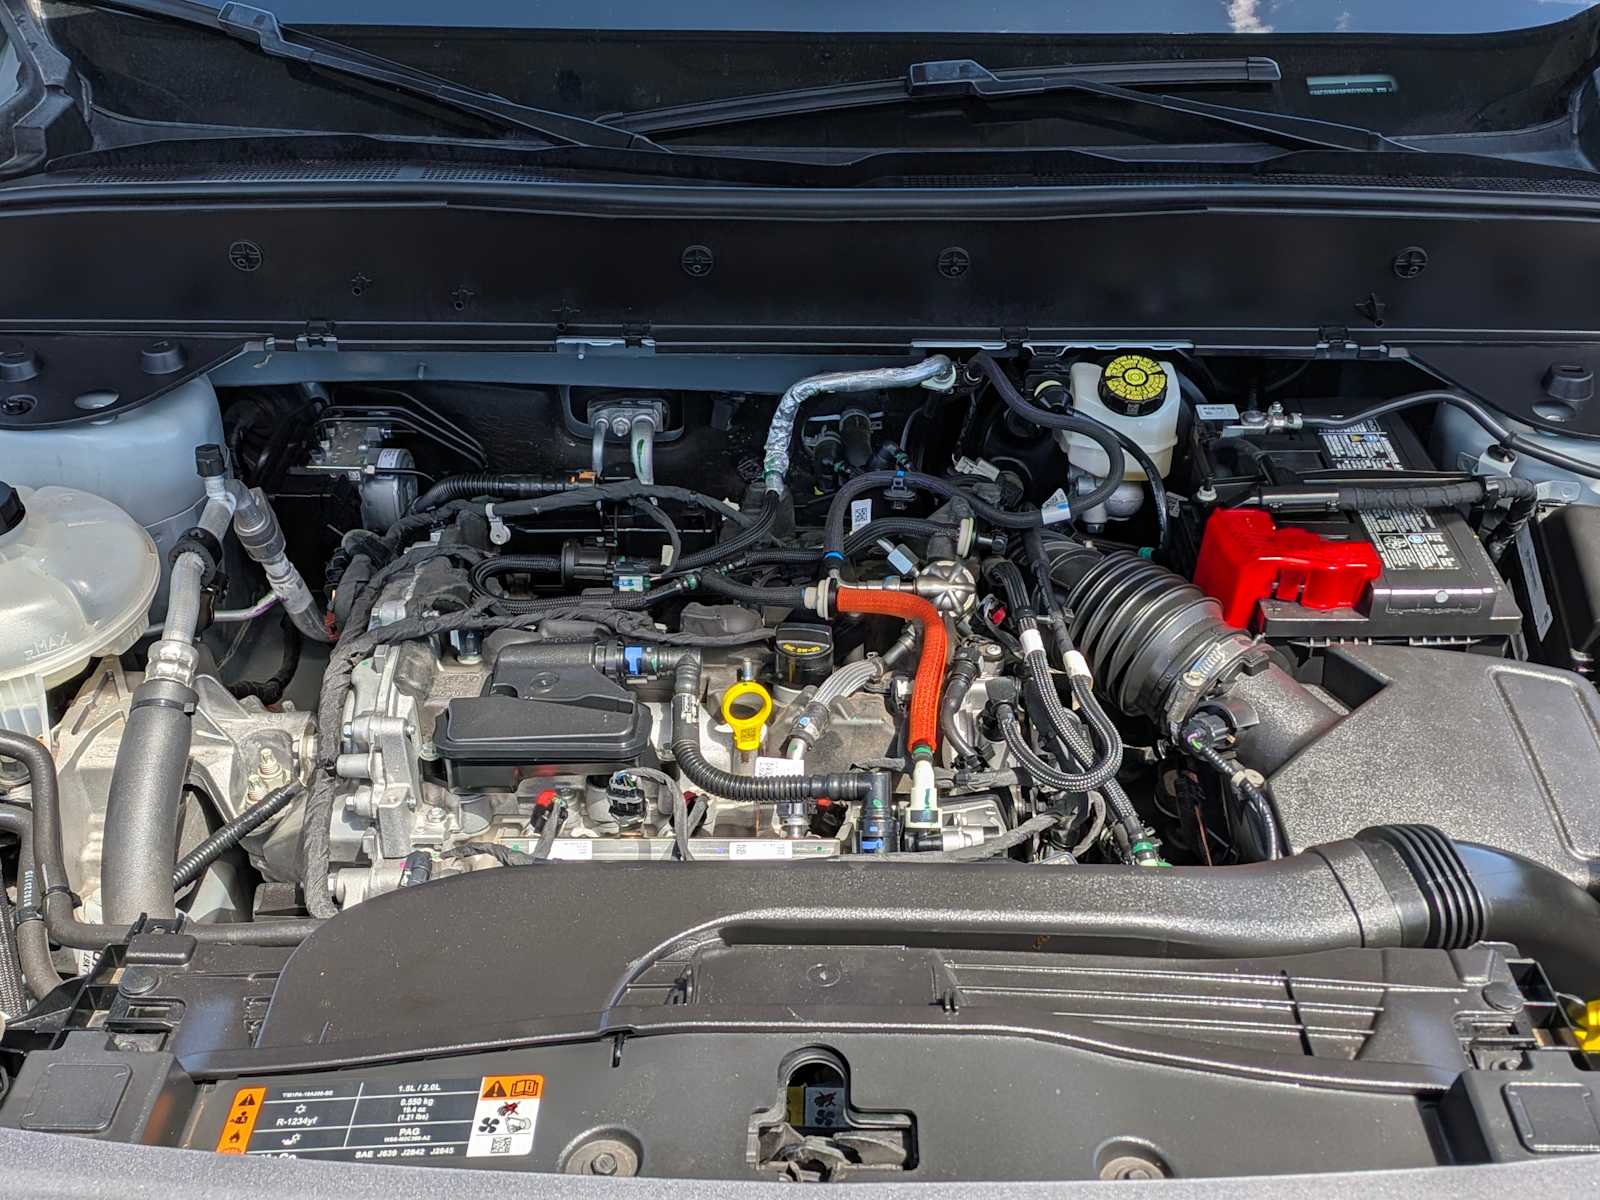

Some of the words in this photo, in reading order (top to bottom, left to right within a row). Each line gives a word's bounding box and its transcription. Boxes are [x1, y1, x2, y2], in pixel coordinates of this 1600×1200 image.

[276, 1116, 318, 1127] R-1234yf
[399, 1127, 420, 1136] PAG
[355, 1150, 374, 1159] SAE
